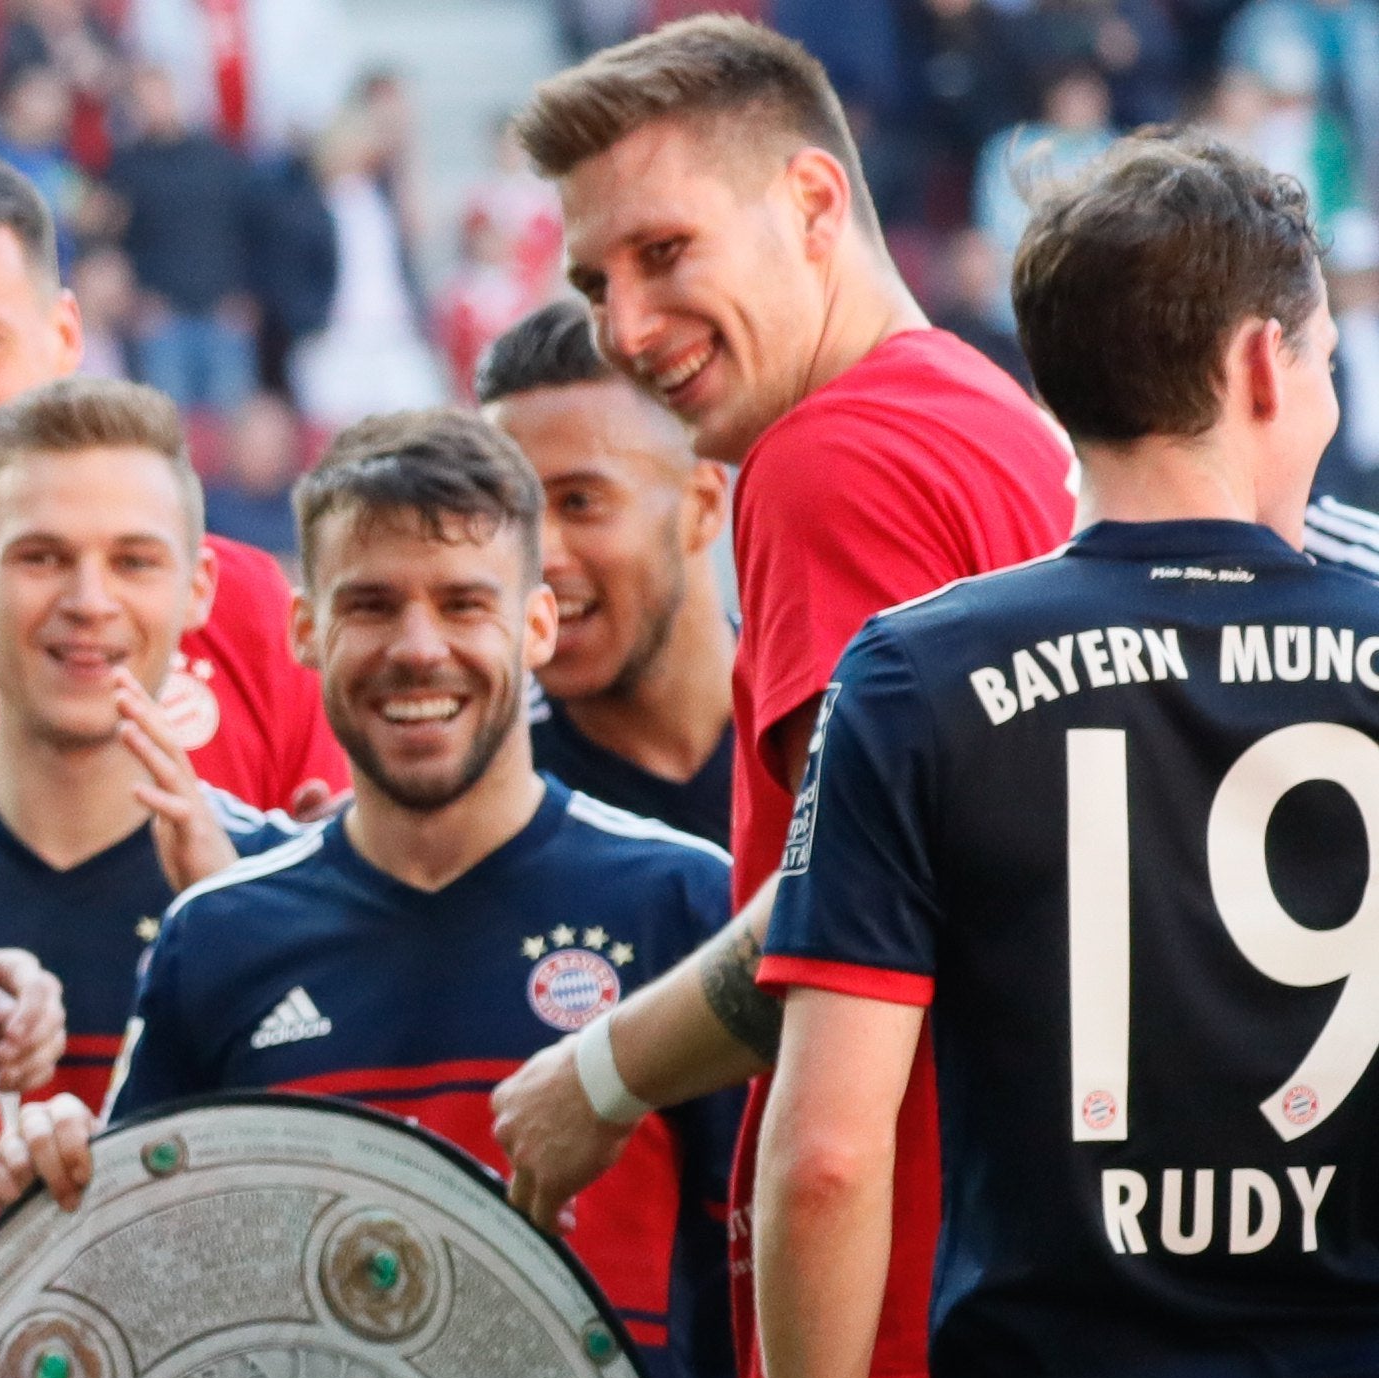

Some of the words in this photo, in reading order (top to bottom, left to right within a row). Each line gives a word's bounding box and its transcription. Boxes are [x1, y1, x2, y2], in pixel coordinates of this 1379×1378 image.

[969, 626, 1188, 726] BAYERN
[1066, 721, 1379, 1142] 19
[1101, 1165, 1336, 1255] RUDY
